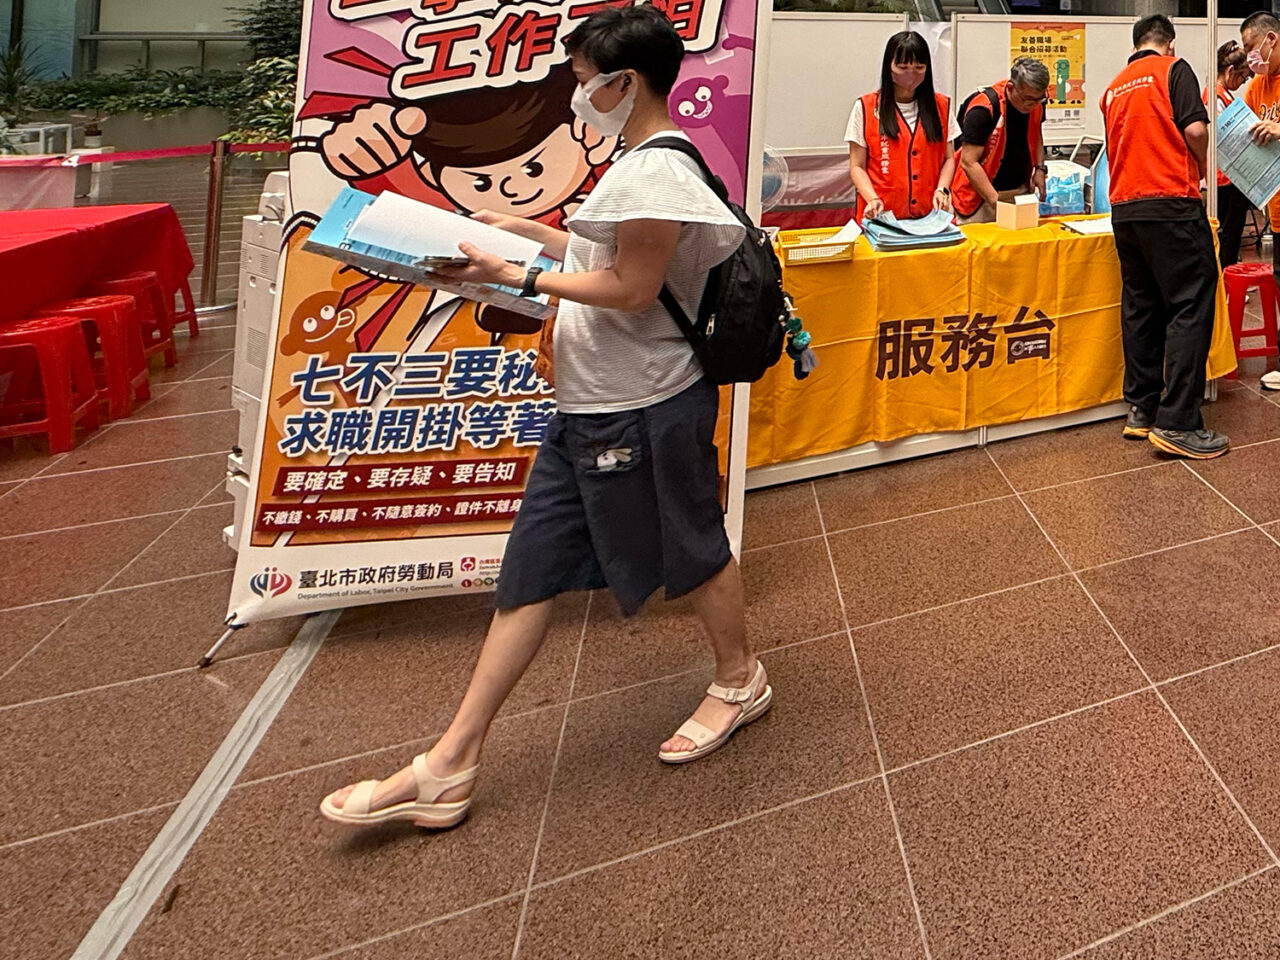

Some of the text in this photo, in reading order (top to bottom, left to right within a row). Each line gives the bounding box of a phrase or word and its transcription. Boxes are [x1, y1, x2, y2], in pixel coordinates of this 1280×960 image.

[875, 306, 1056, 380] 服務台
[292, 347, 554, 407] 七不三要秘
[279, 399, 557, 458] 求職開掛等著
[283, 462, 517, 492] 要確定、要存疑、要告知
[298, 561, 454, 589] 臺北市政府勞動局
[298, 591, 340, 600] Department
[351, 588, 372, 596] Labor,
[373, 587, 394, 595] Taipei
[410, 583, 454, 592] Government
